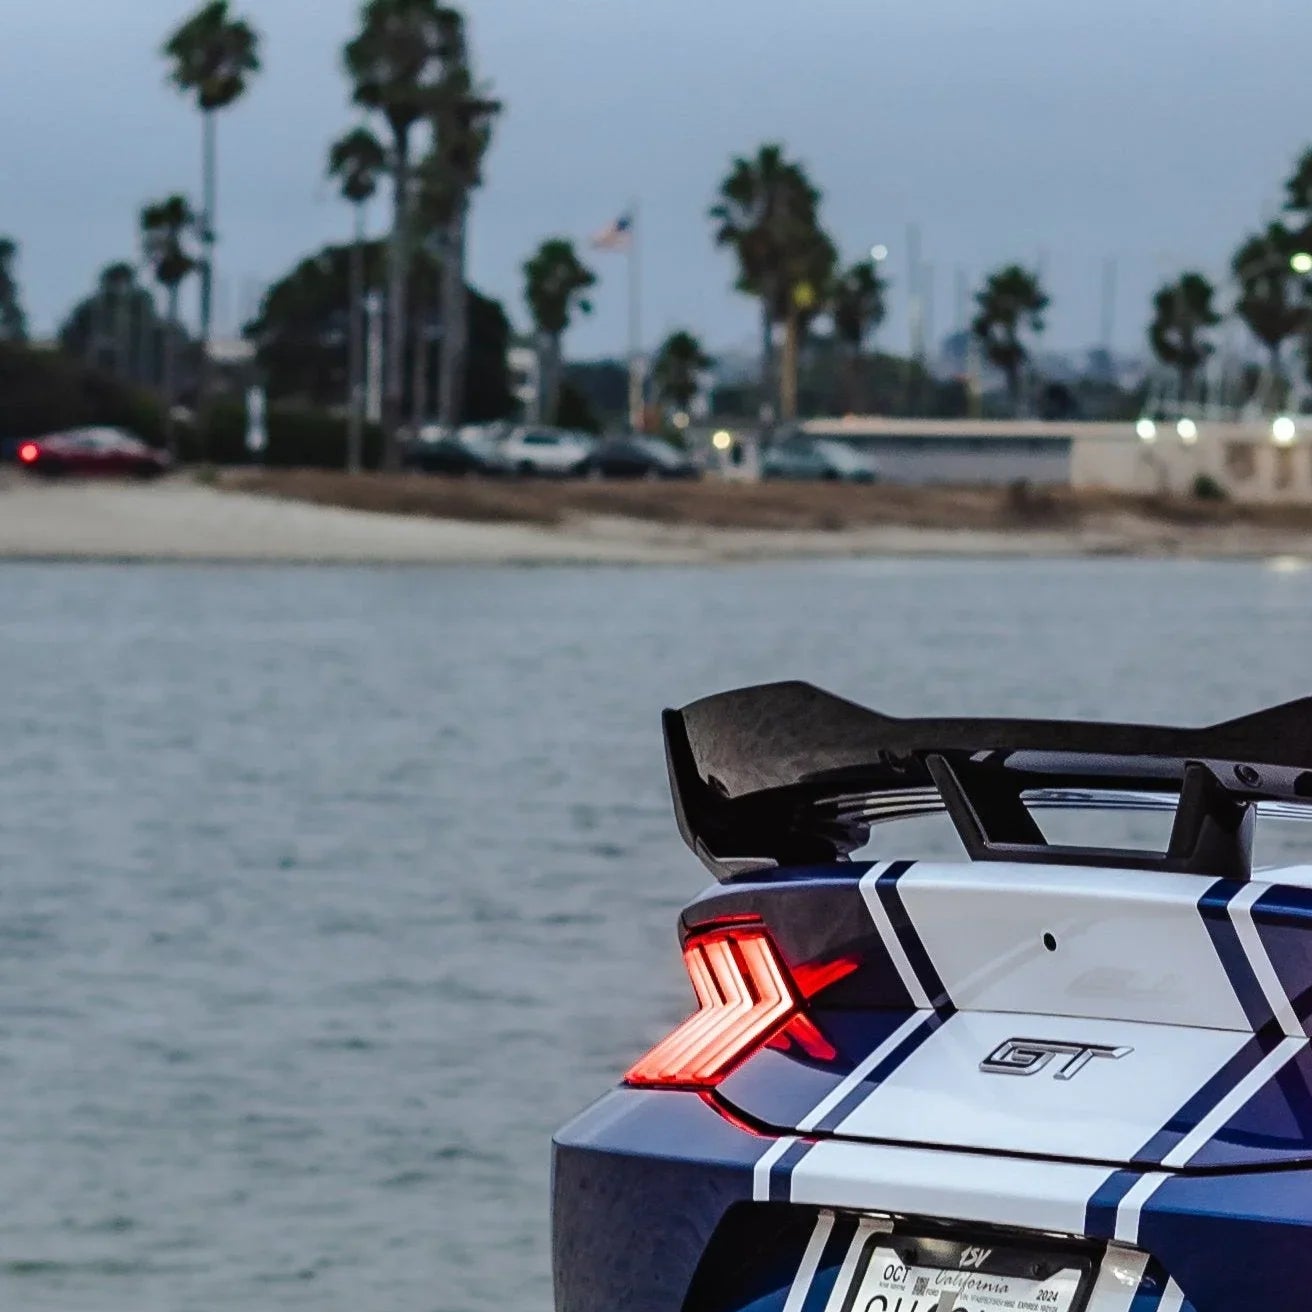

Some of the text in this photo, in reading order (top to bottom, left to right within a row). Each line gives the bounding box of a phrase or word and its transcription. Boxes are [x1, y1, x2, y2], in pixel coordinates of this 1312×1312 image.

[979, 1037, 1136, 1080] GT
[883, 1264, 911, 1283] OCT
[935, 1270, 1009, 1298] California
[1036, 1288, 1059, 1302] 2024
